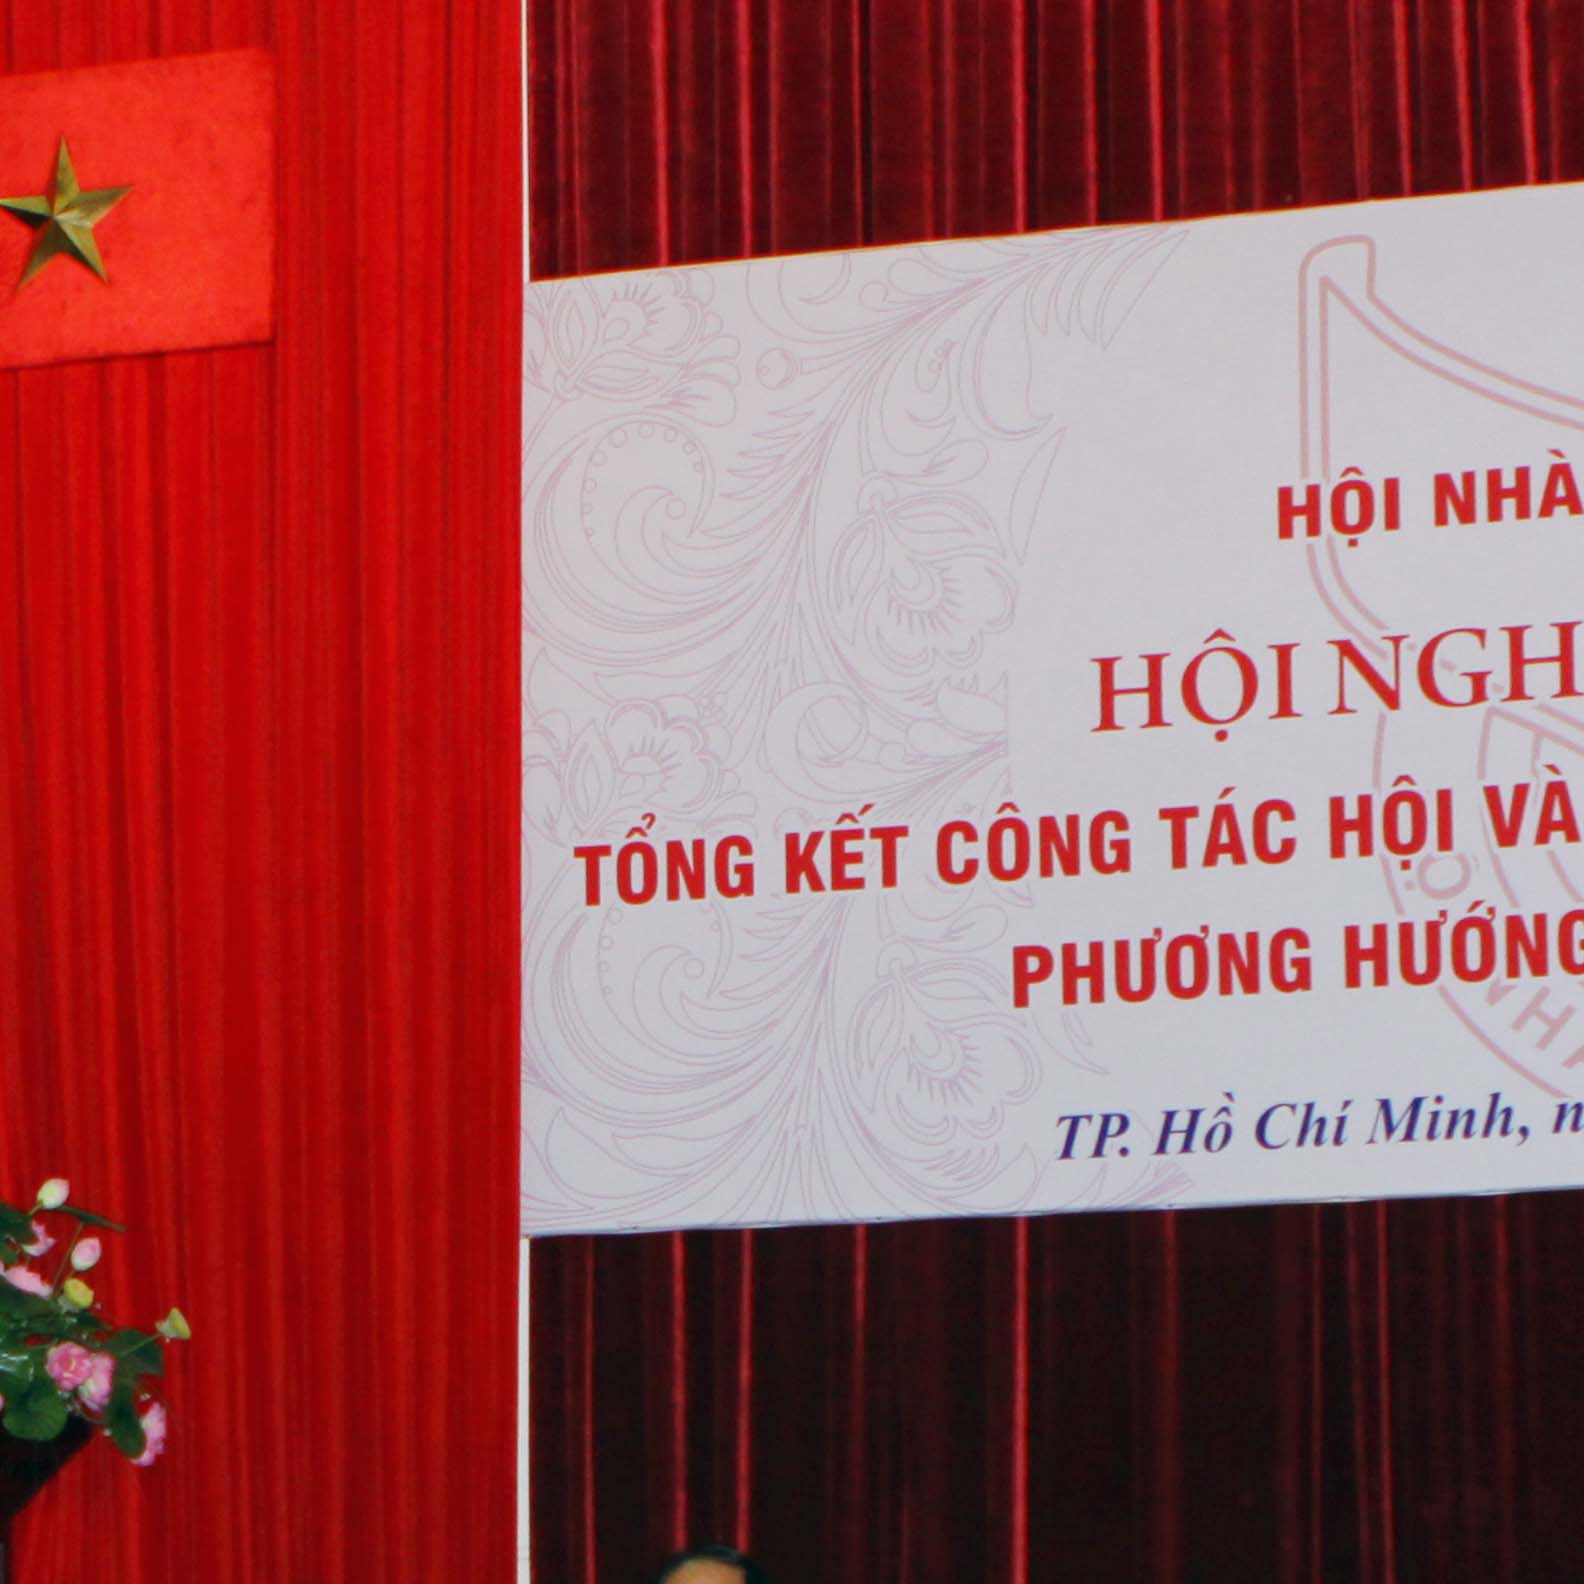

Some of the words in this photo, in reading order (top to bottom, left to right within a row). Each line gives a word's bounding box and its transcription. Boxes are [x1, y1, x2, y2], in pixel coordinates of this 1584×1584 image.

[1278, 467, 1400, 547] HỘI
[1434, 450, 1583, 526] NHÀ
[1093, 629, 1300, 741] HỘI
[574, 813, 754, 906] TỔNG
[785, 804, 909, 893] KẾT
[937, 802, 1131, 884] CÔNG
[1159, 787, 1296, 869] TÁC
[1330, 775, 1453, 870] HỘI
[1484, 764, 1580, 847] VÀ
[1013, 925, 1312, 1008] PHƯƠNG
[1056, 1114, 1129, 1159] TP.
[1155, 1093, 1232, 1154] Hồ
[1256, 1100, 1351, 1149] Chí
[1368, 1093, 1529, 1143] Minh,
